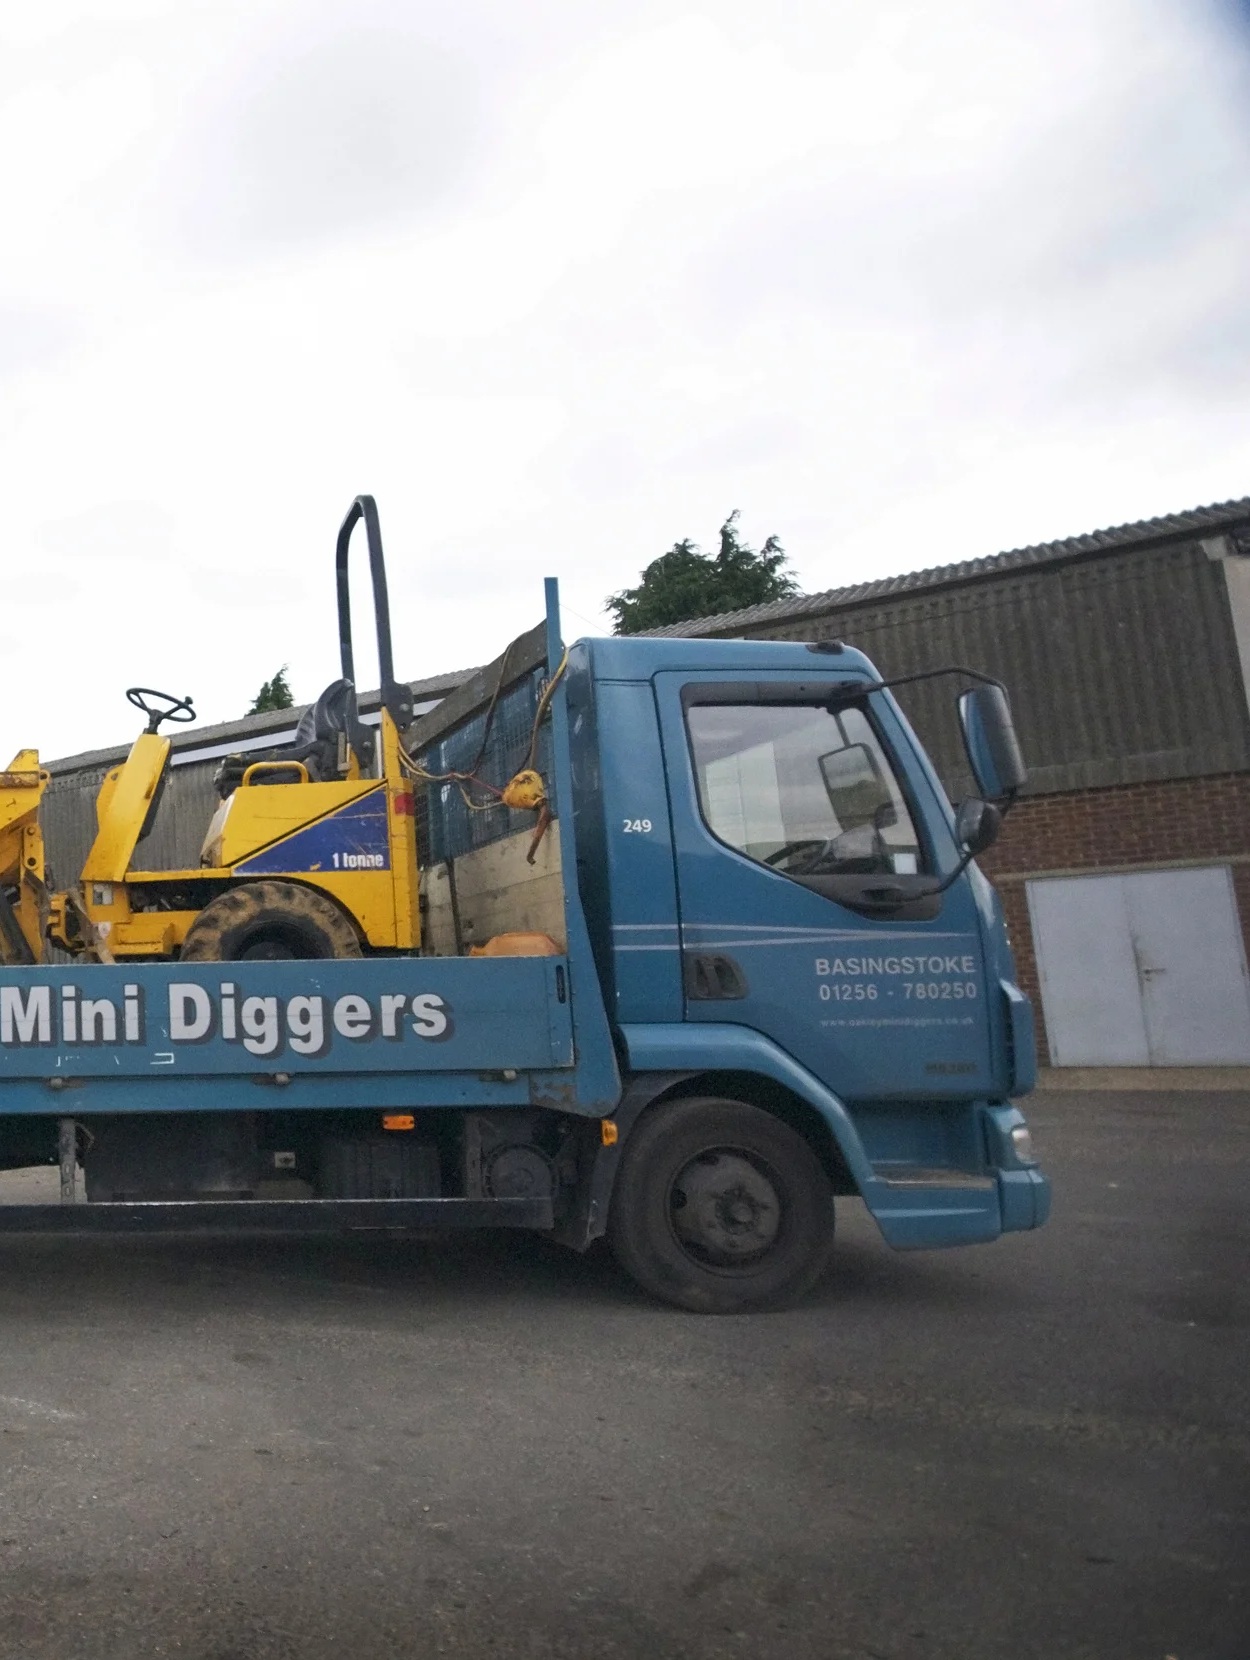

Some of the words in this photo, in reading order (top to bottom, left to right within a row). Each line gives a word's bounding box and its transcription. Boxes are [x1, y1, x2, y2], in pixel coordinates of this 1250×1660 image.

[623, 819, 652, 833] 249
[332, 852, 340, 869] 1
[342, 852, 384, 868] tonne
[815, 956, 976, 976] BASINGSTOKE
[819, 984, 878, 1001] 01256
[903, 982, 977, 999] 780250
[0, 984, 141, 1043] Mini
[168, 982, 449, 1055] Diggers
